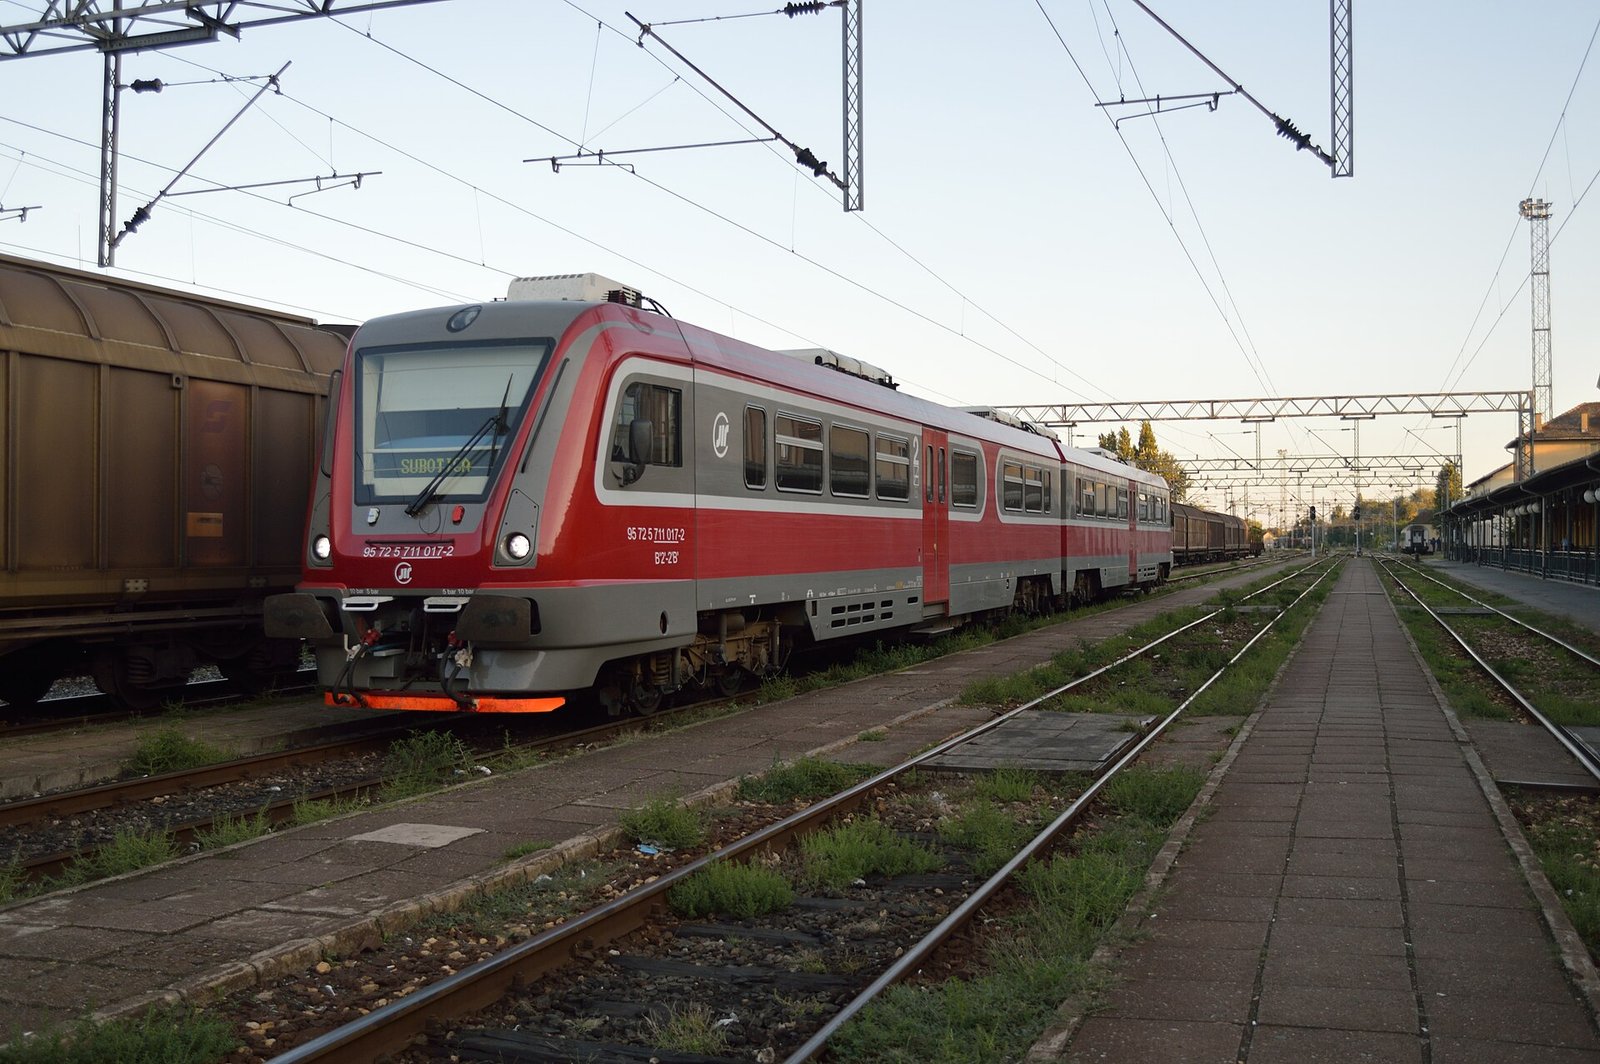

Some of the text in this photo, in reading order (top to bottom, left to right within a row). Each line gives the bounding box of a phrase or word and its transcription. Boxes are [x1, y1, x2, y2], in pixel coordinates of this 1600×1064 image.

[627, 527, 685, 541] 95 72 5 711 017-2
[363, 545, 454, 557] 95 72 5 711 017-2
